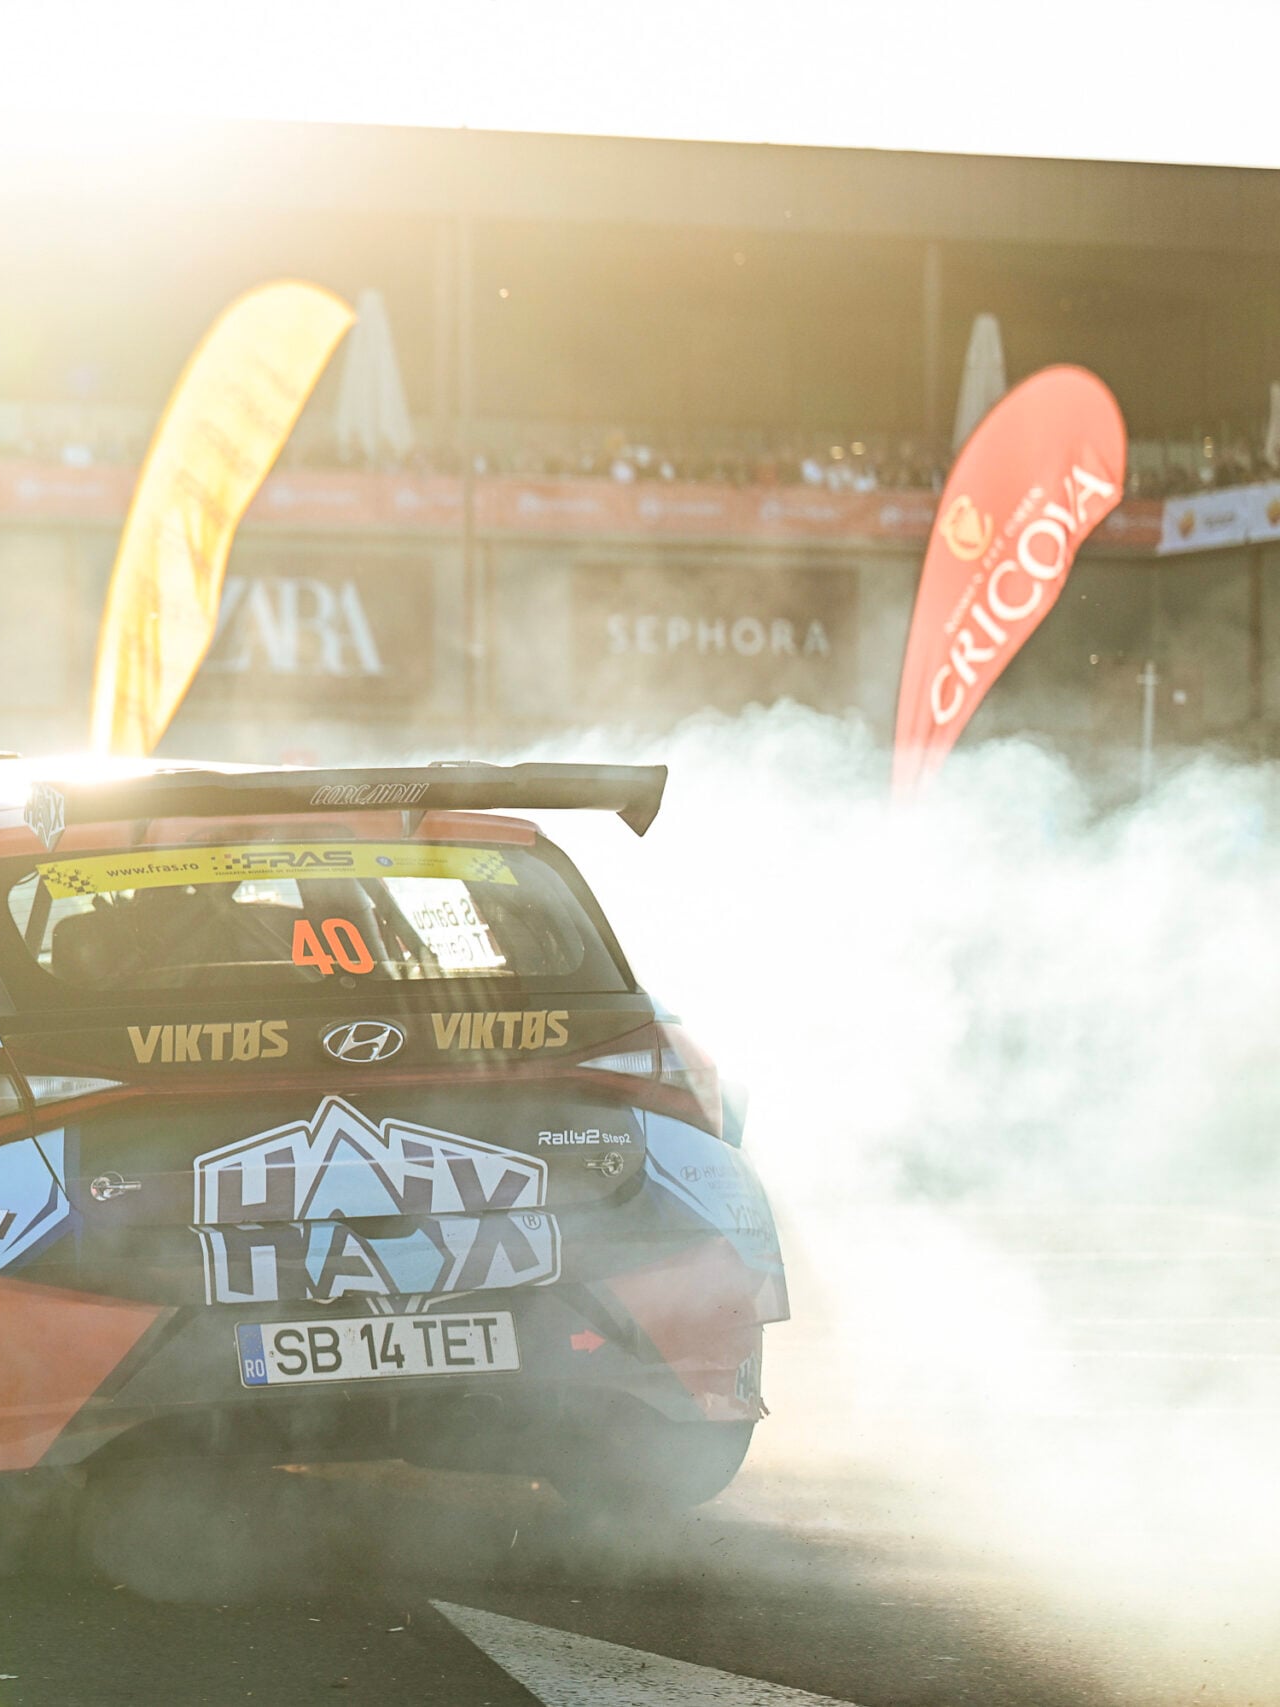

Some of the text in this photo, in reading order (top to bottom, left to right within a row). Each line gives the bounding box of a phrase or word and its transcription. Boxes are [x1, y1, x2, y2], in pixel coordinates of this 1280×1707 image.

[931, 465, 1115, 725] CRICOVA
[605, 614, 830, 657] SEPHORA
[106, 862, 200, 878] www.fras.ro
[241, 851, 354, 868] FRAS
[292, 917, 375, 975] 40
[127, 1019, 289, 1064] VIKTØS
[431, 1009, 570, 1052] VIKTØS
[538, 1129, 632, 1146] Rally2 Step2
[273, 1317, 498, 1376] SB 14 TET
[245, 1360, 266, 1378] RO
